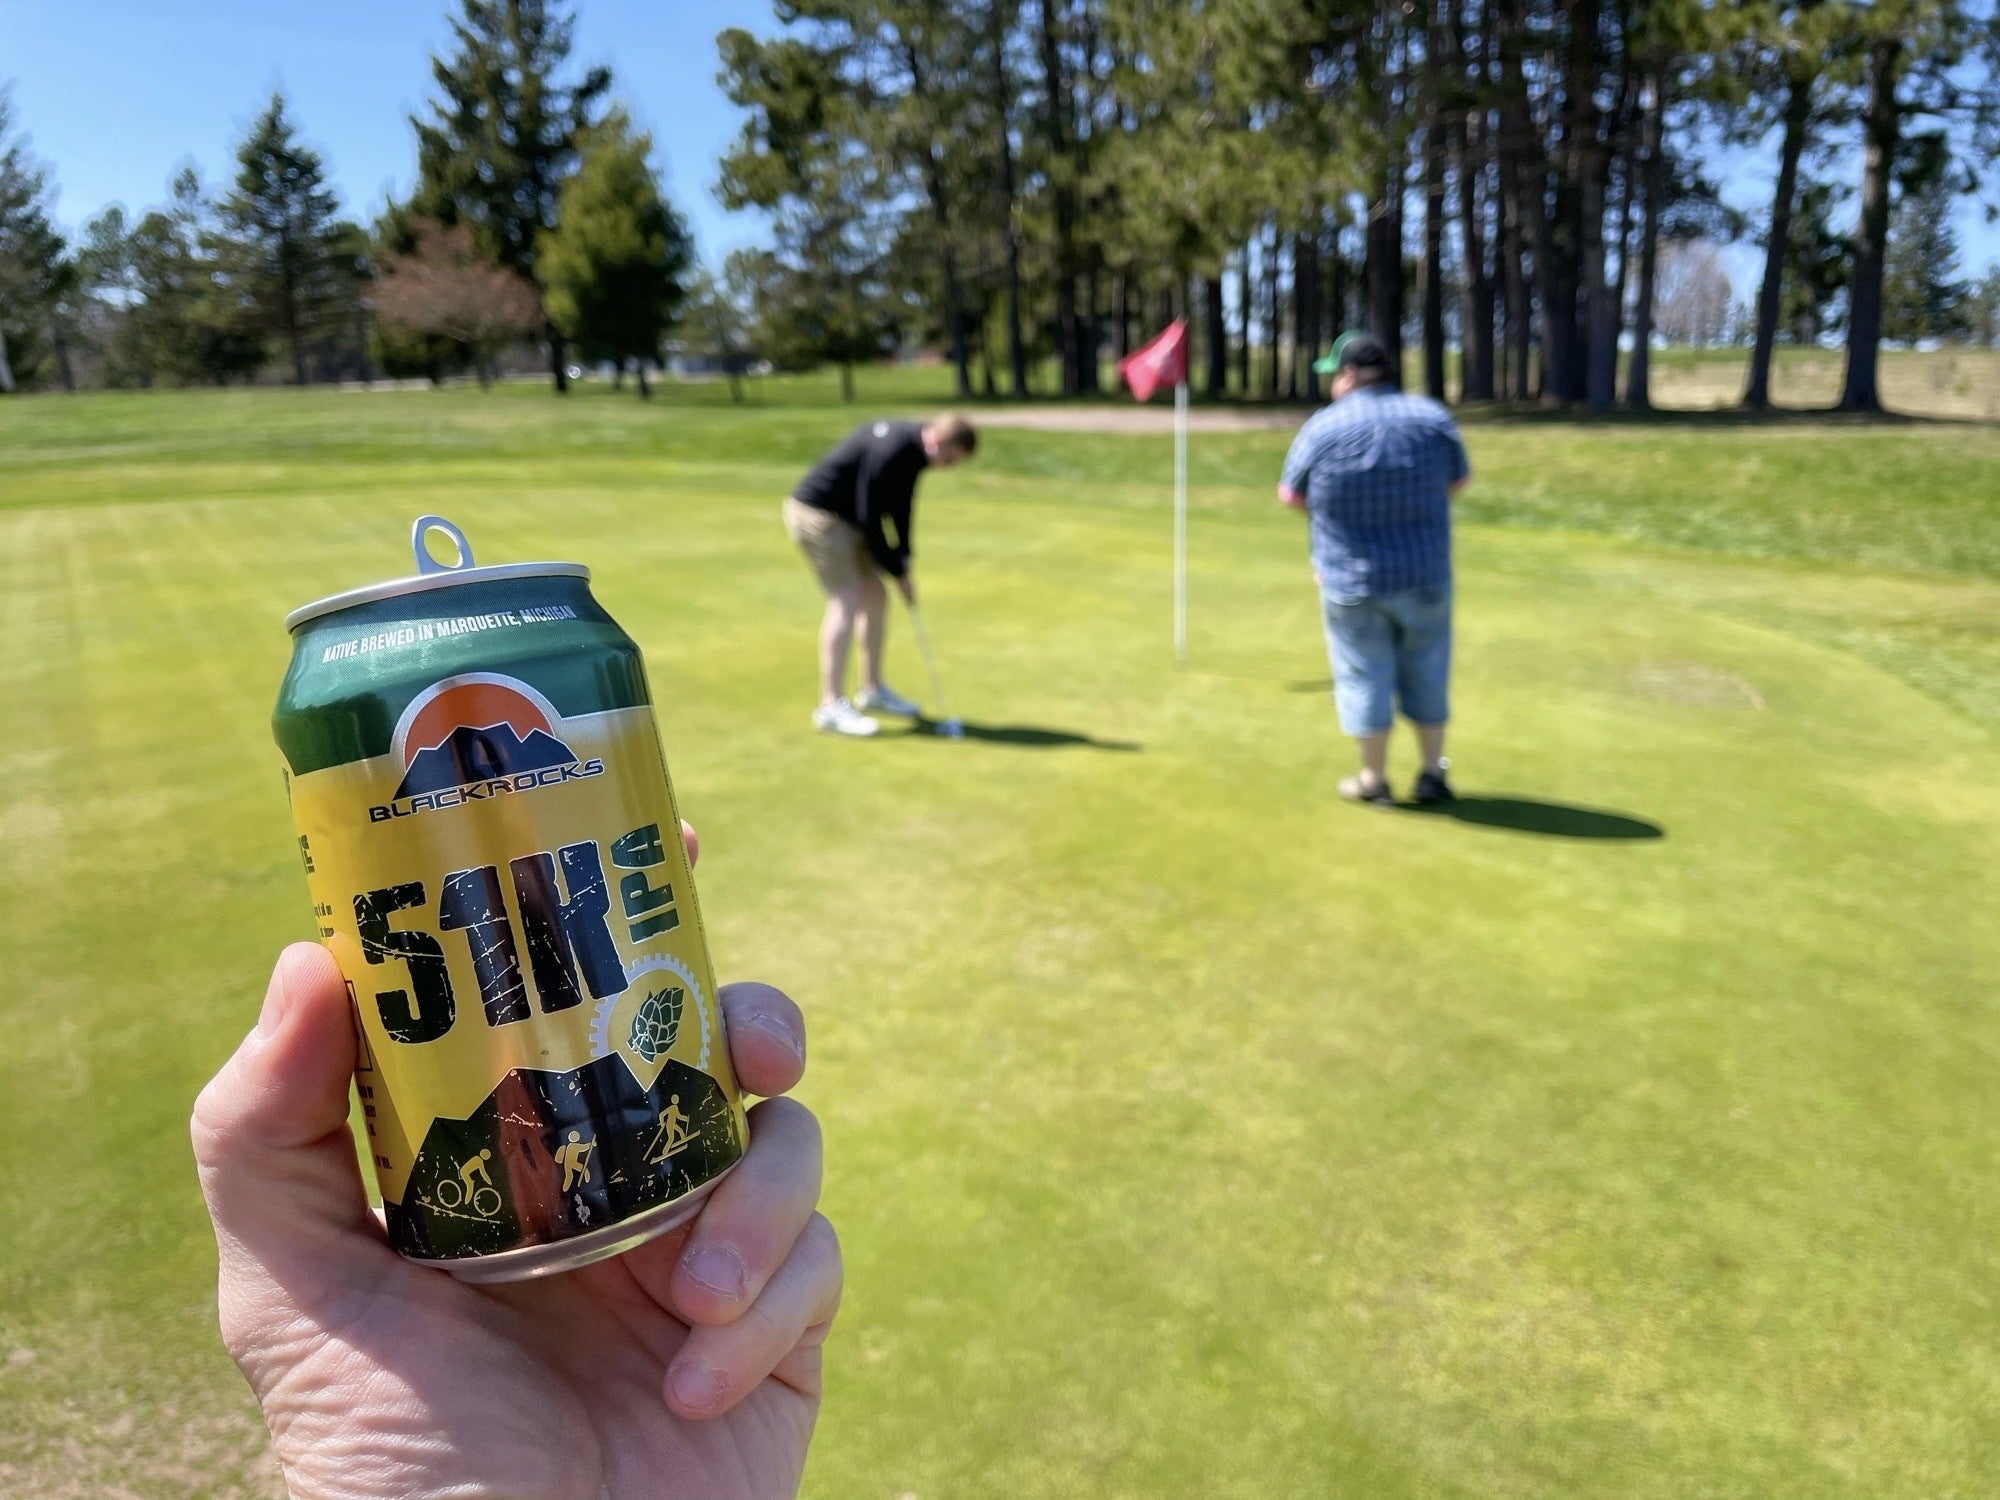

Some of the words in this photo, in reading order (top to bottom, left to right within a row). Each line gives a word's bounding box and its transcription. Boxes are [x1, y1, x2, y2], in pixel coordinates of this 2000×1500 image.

[322, 640, 358, 664] NATIVE
[360, 629, 415, 655] BREWED
[418, 624, 434, 642] IN
[437, 610, 522, 638] MARQUETTE,
[520, 605, 577, 624] MICHIGAN
[368, 758, 605, 823] BLACKROCKS
[610, 823, 681, 945] IPA
[352, 839, 630, 1044] 51K
